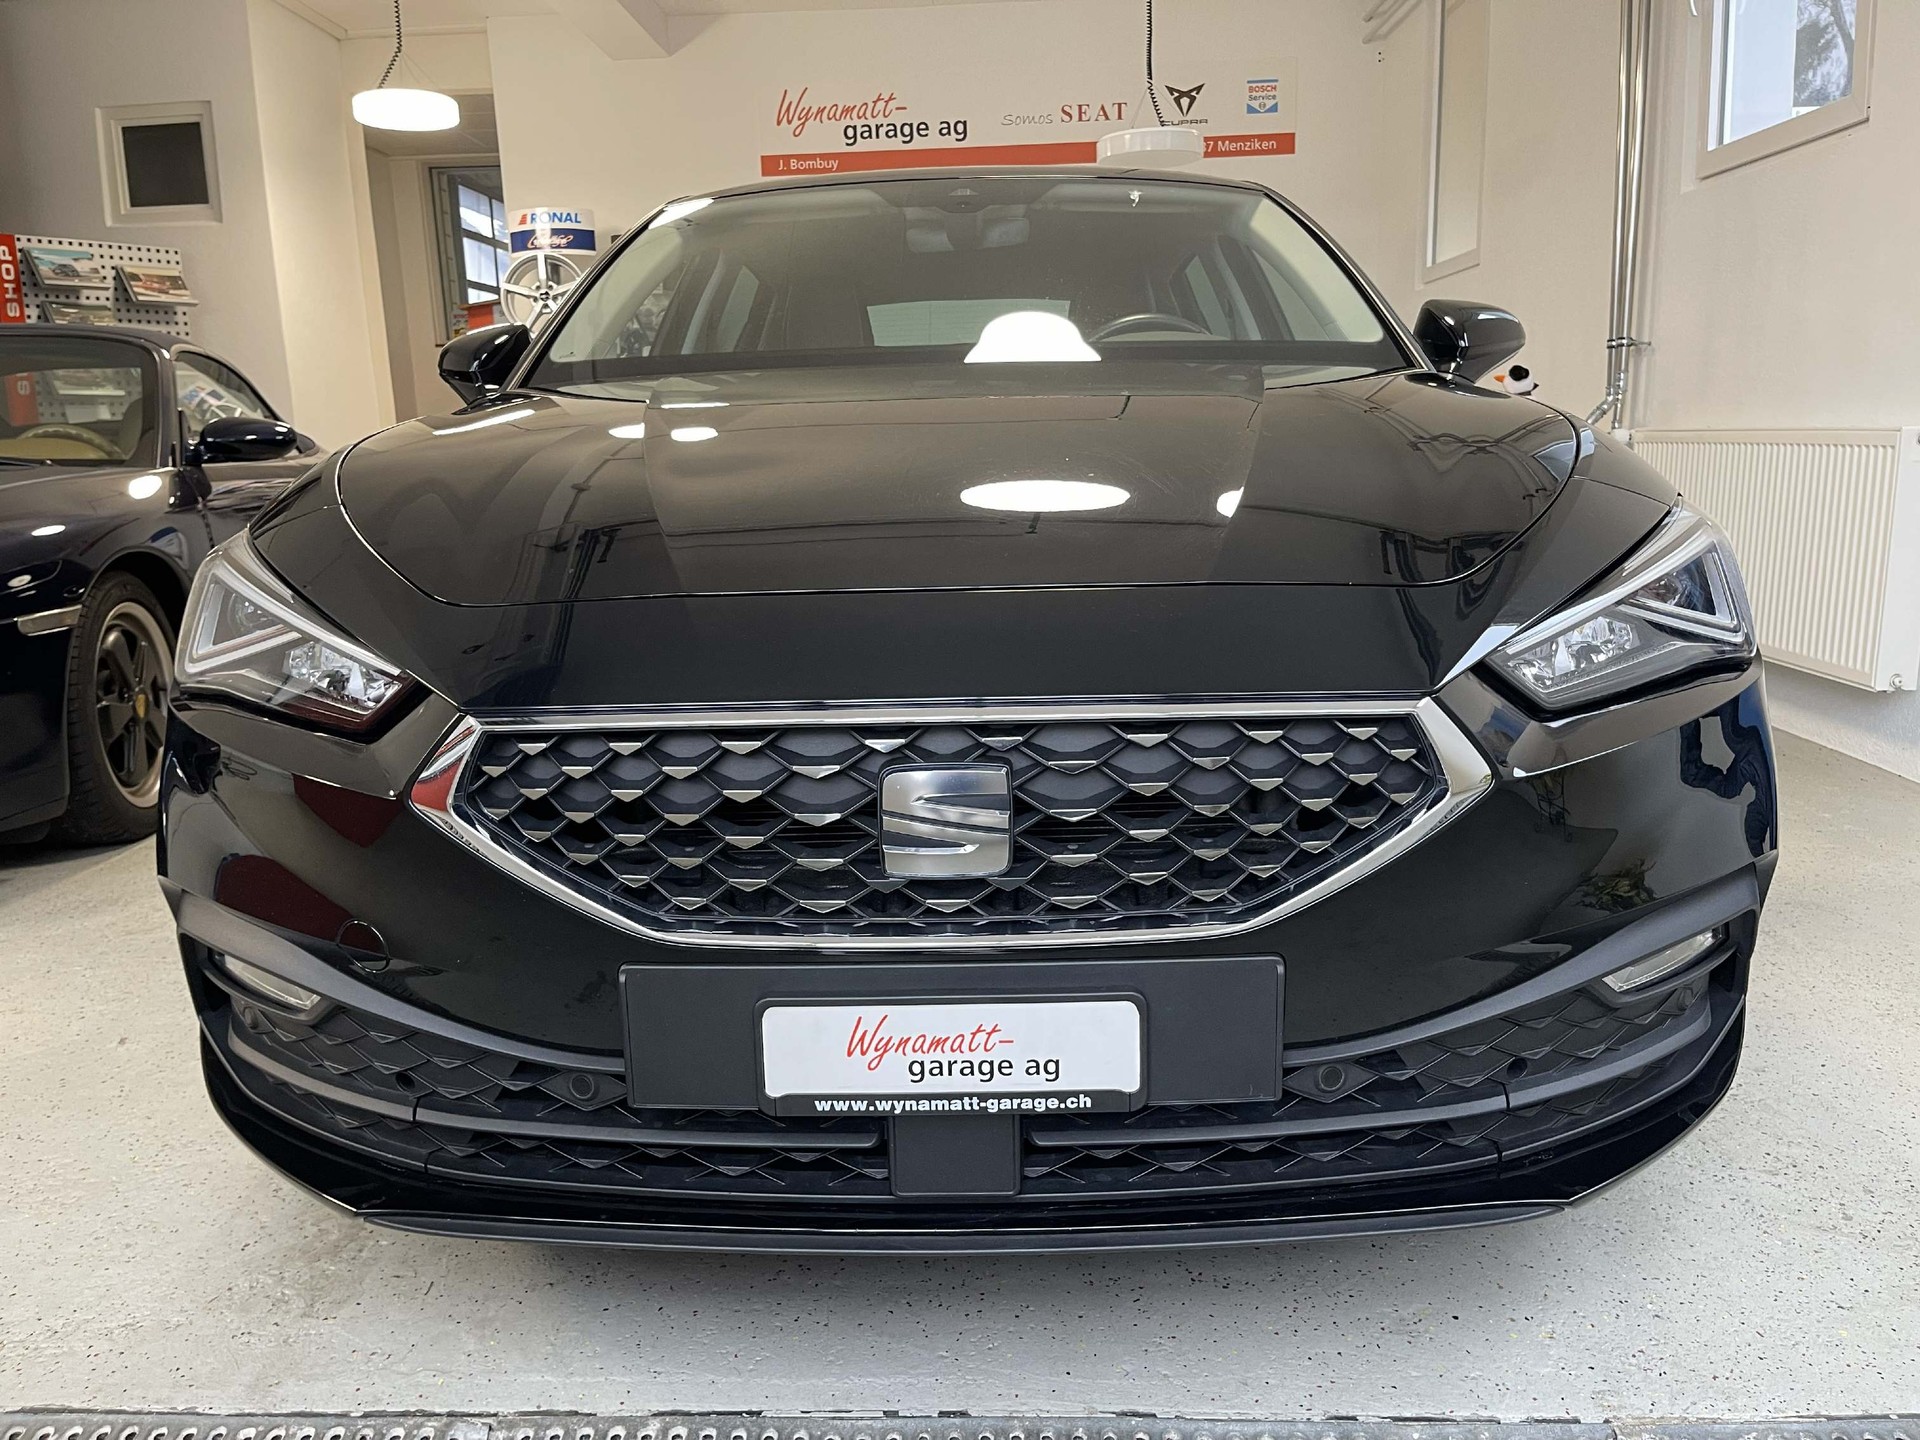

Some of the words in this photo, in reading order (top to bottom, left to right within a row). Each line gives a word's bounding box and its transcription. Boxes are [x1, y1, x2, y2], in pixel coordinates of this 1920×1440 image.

[1248, 84, 1277, 94] BOSCH
[1248, 93, 1277, 102] Service
[776, 86, 908, 138] Wynamatt-
[1060, 102, 1128, 123] SEAT
[843, 119, 930, 147] garage
[938, 118, 968, 142] ag
[1160, 118, 1208, 127] CUPRA
[1217, 139, 1277, 153] Menziken
[778, 159, 787, 171] J.
[790, 158, 839, 172] Bombuy
[530, 211, 582, 225] RONAL
[0, 245, 20, 318] SHOP
[846, 1013, 1014, 1071] Wynamatt-
[908, 1058, 1014, 1083] garage
[1025, 1056, 1061, 1082] ag
[814, 1094, 1092, 1114] www.wynamatt-garage.ch
